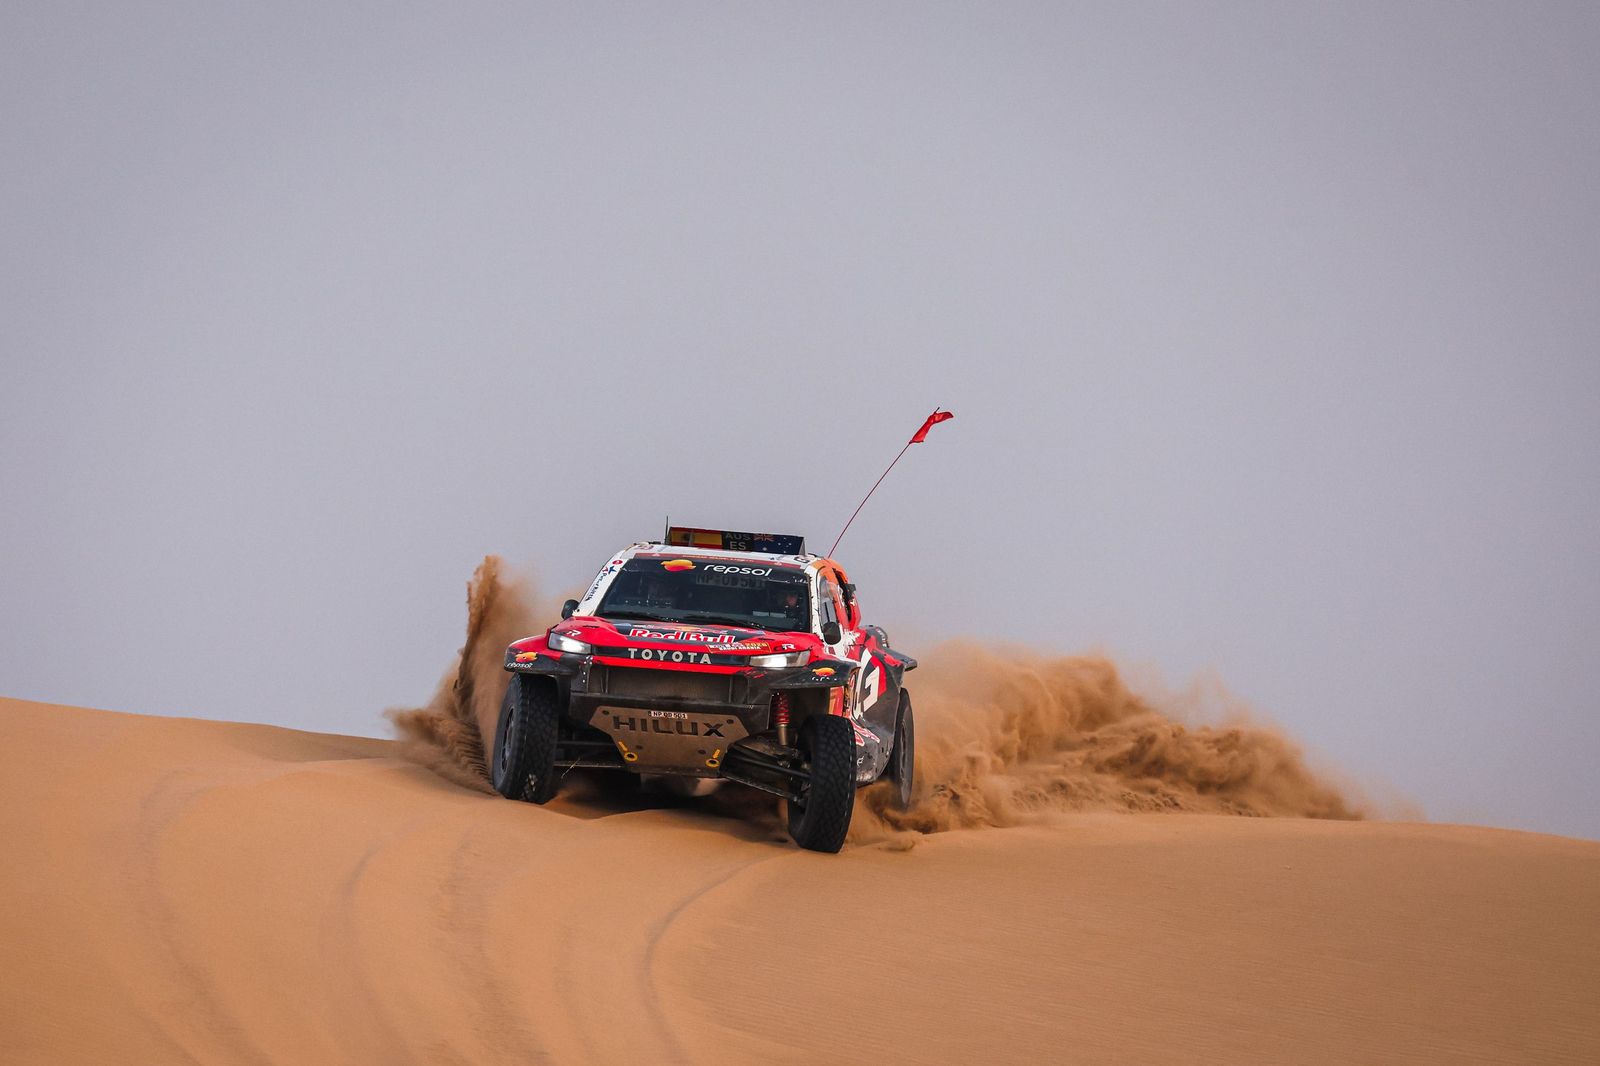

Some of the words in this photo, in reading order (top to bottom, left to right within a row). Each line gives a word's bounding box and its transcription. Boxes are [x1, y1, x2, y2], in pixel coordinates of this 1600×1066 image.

[724, 531, 751, 541] AUS
[729, 541, 746, 550] ES
[703, 564, 773, 577] repsol
[628, 628, 684, 641] Red
[682, 632, 736, 644] Bull
[627, 647, 712, 665] TOYOTA
[613, 715, 725, 738] HILUX
